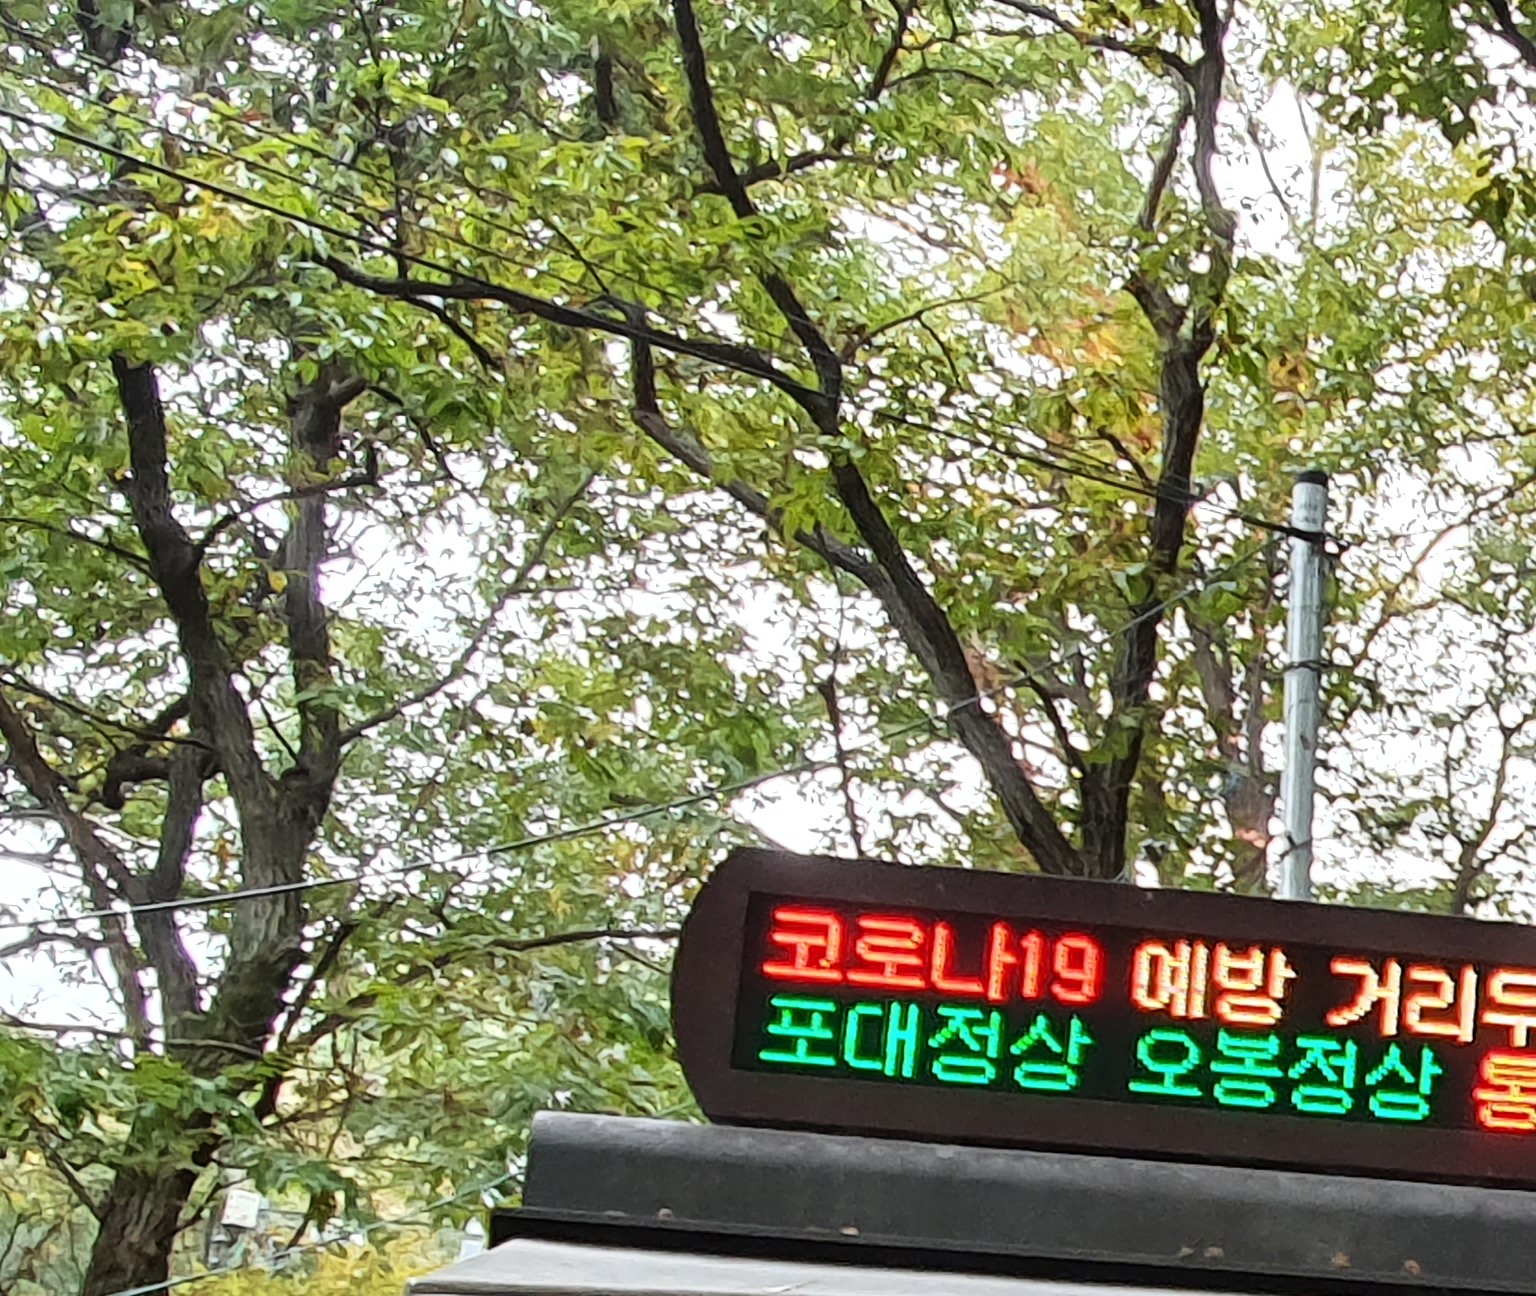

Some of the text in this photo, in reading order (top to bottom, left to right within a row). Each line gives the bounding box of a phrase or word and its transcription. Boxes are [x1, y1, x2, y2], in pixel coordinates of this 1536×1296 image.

[758, 903, 1106, 1004] 코로나19
[1128, 940, 1296, 1027] 예방
[755, 992, 1094, 1093] 포대정상
[1128, 1027, 1442, 1124] 오봉정상
